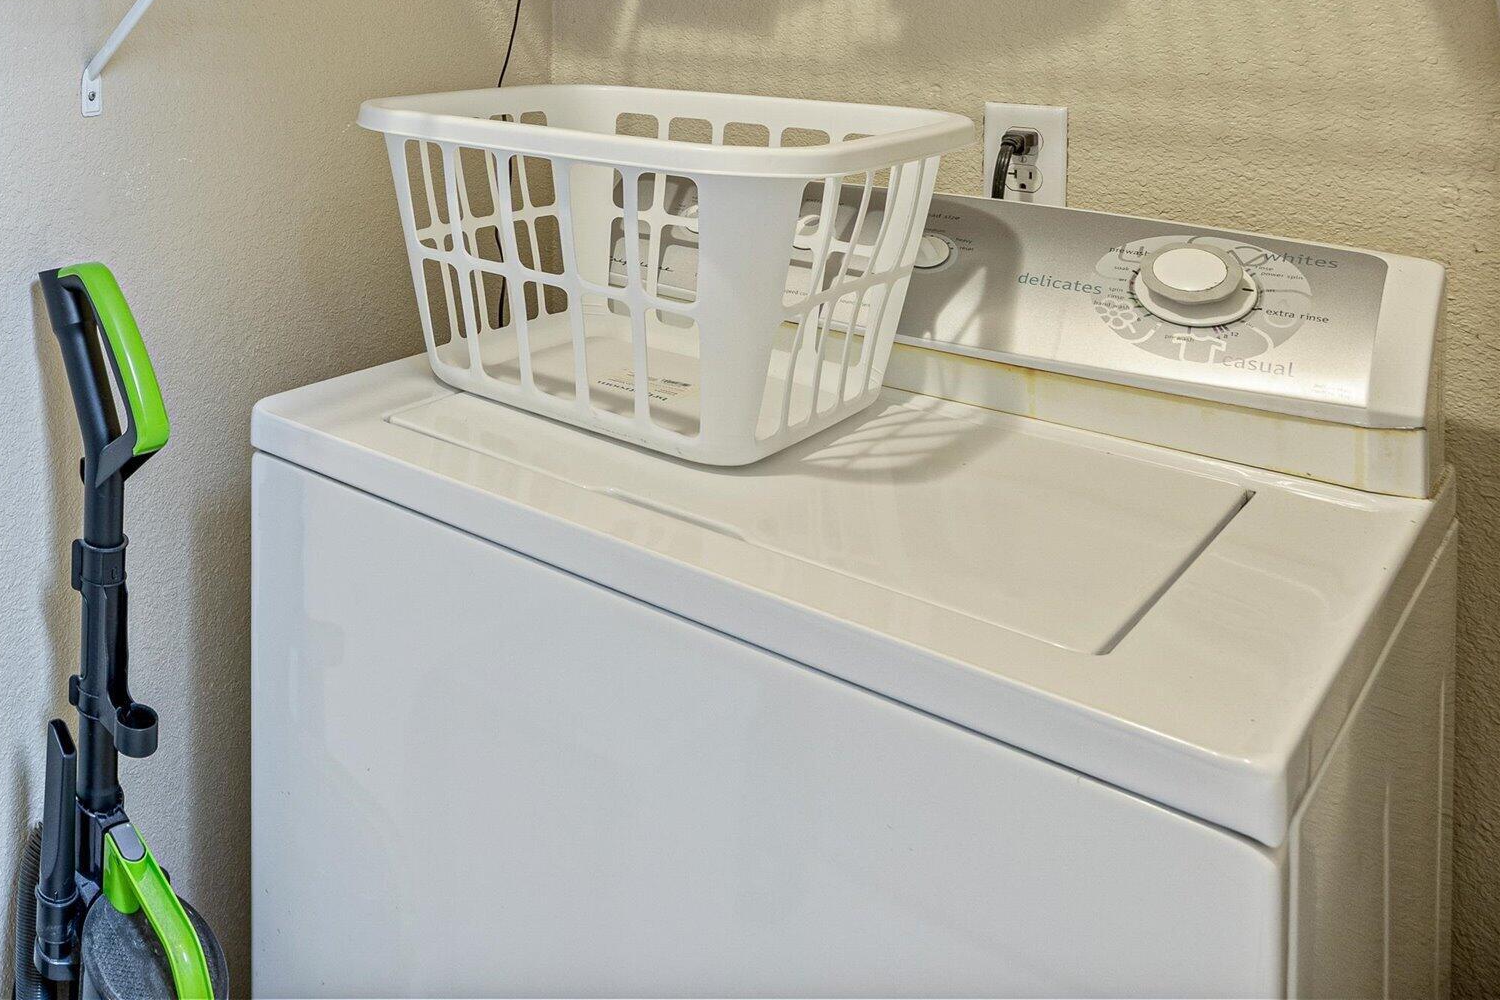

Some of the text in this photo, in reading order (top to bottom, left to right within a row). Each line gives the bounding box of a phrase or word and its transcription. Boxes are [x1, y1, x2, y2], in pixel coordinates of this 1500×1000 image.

[1263, 252, 1340, 270] whites
[1017, 271, 1103, 296] delicates
[1260, 270, 1285, 279] power
[1265, 309, 1330, 324] extra rinse
[1222, 353, 1295, 378] casual
